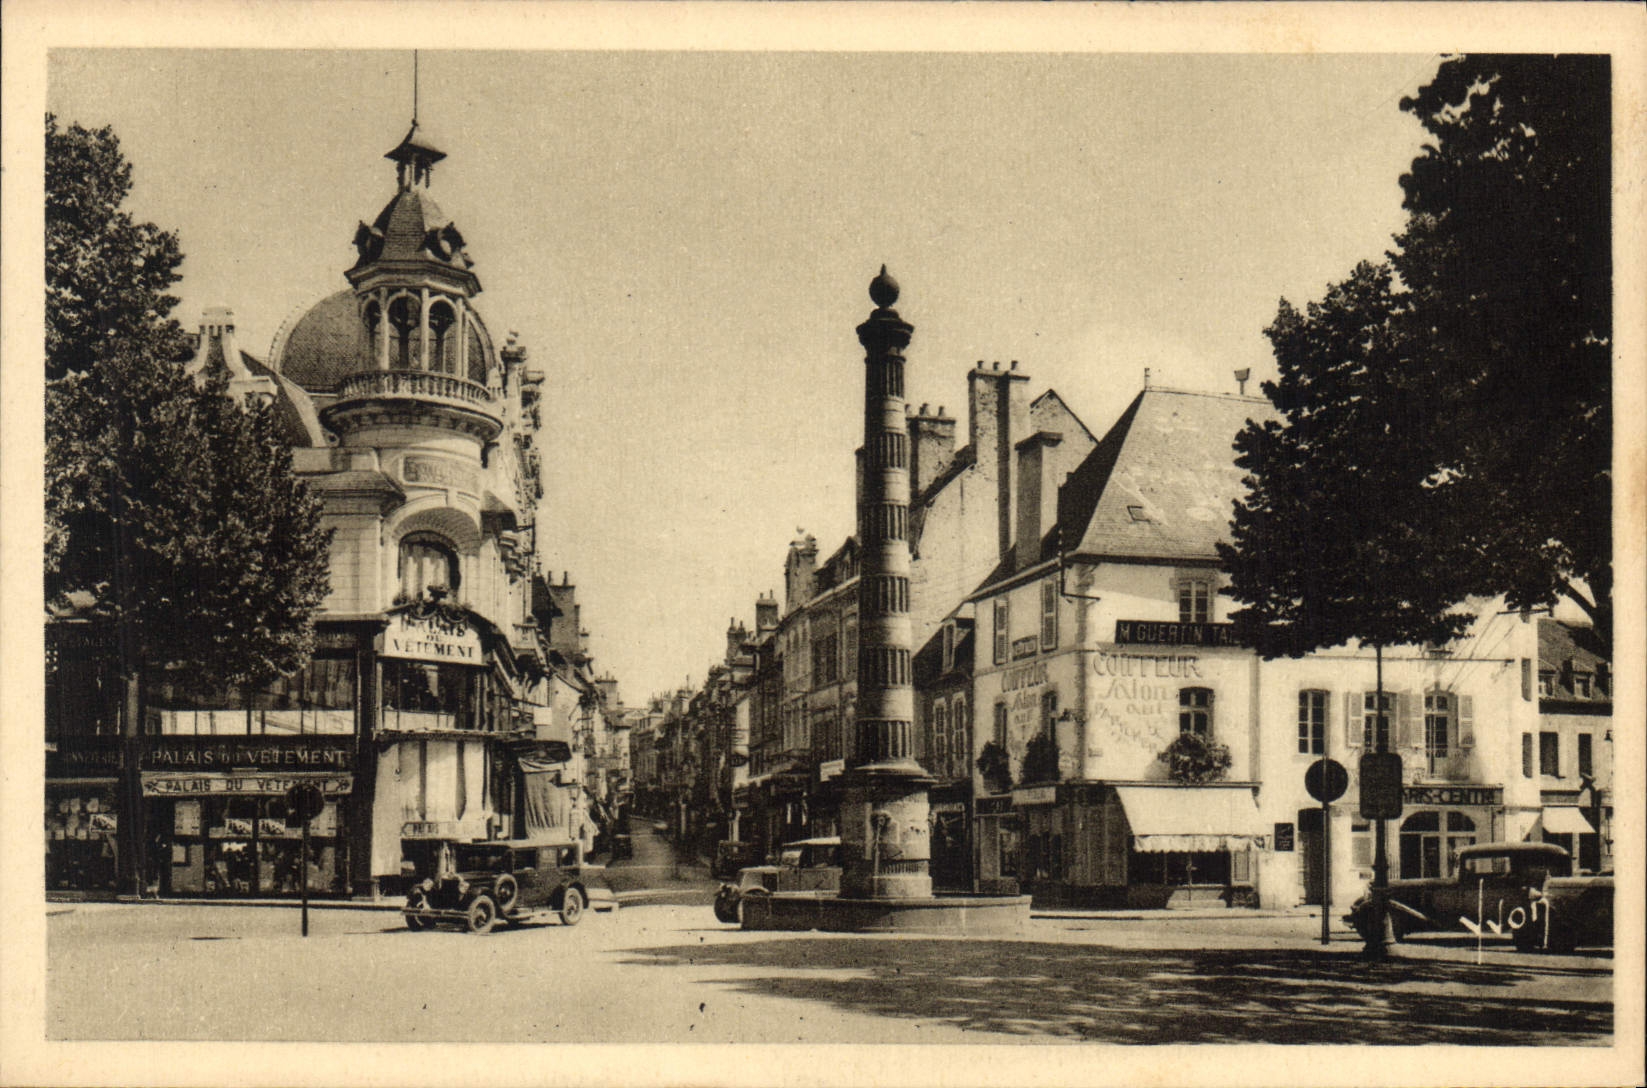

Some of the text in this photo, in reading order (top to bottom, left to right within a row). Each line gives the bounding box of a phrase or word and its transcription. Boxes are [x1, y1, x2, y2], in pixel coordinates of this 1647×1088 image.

[151, 750, 214, 764] PALAIS
[165, 780, 211, 792] PALAIS
[226, 779, 243, 791] DU
